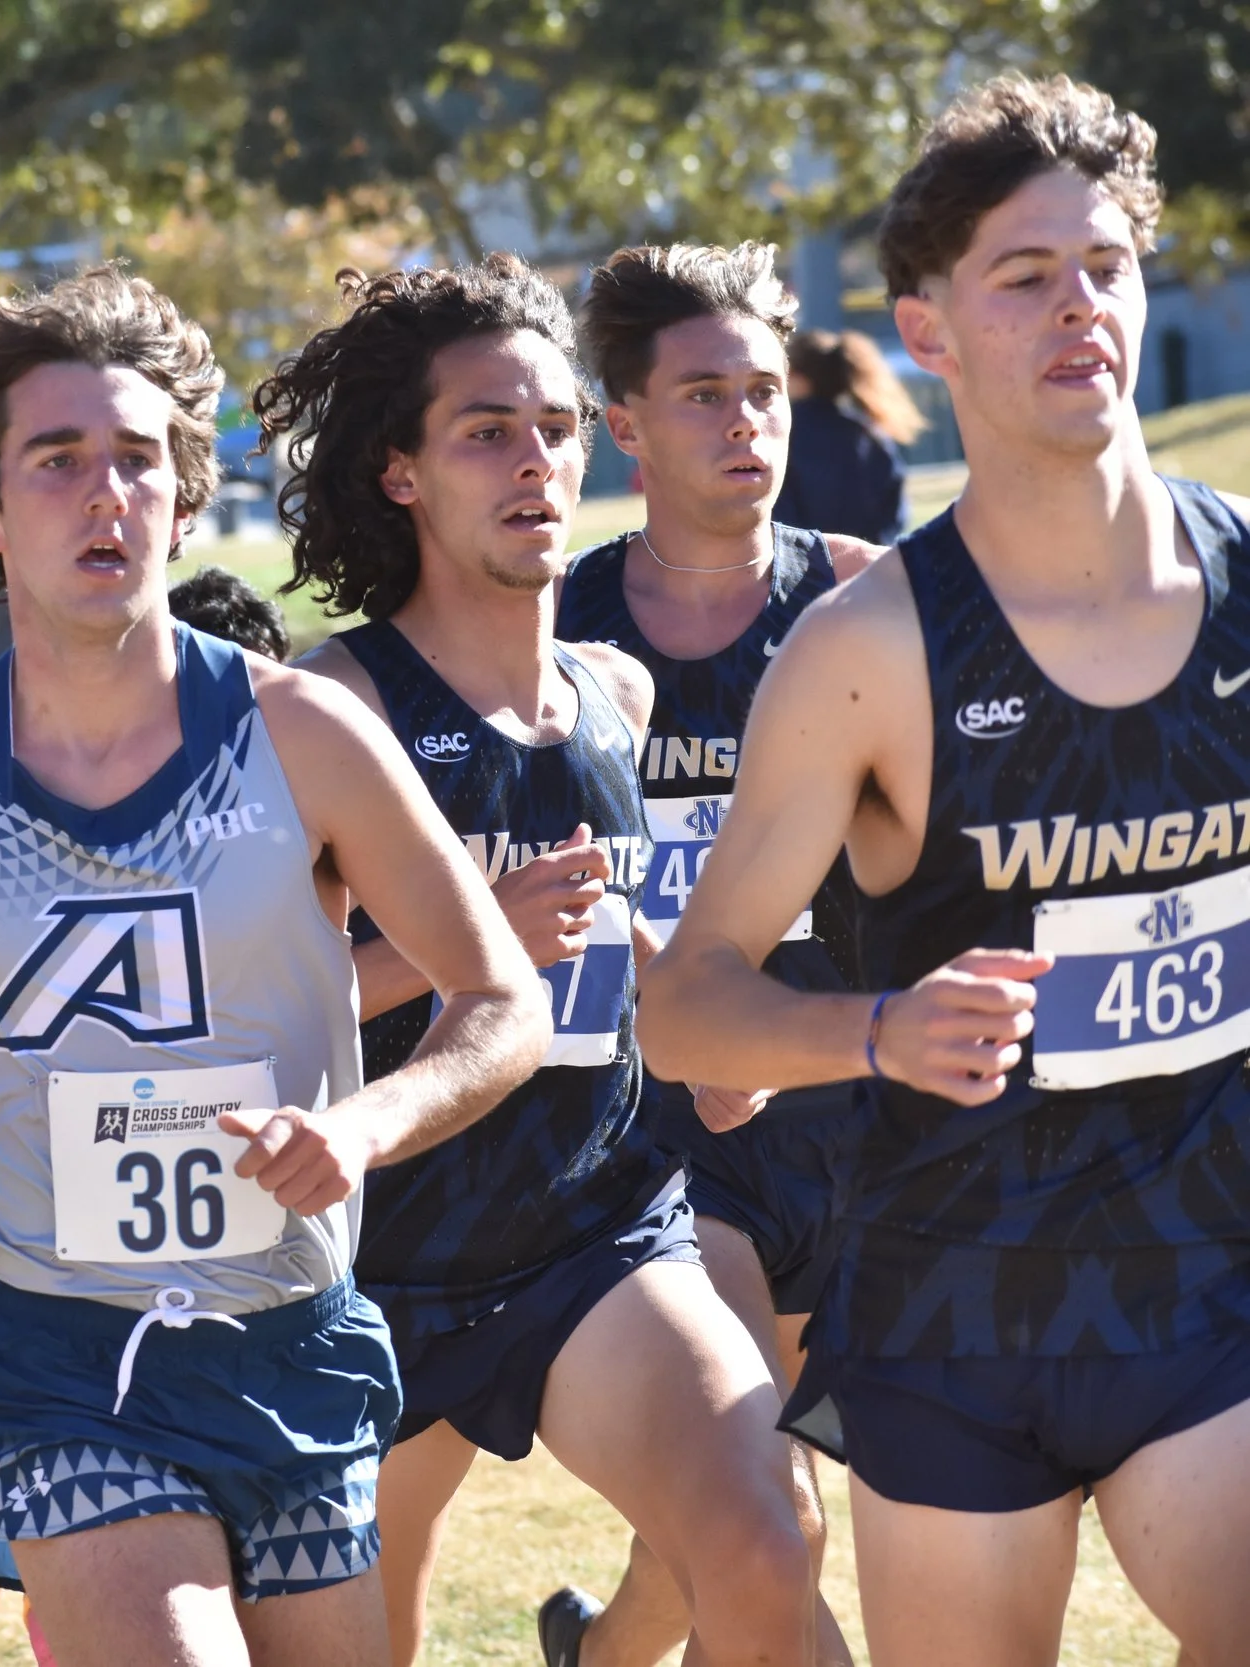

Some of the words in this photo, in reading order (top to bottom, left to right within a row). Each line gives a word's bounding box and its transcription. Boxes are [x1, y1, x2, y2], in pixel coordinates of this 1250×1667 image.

[964, 696, 1026, 731] SAC
[422, 732, 470, 755] SAC
[185, 802, 269, 848] PBC
[1095, 940, 1224, 1041] 463
[131, 1119, 206, 1133] CHAMPIONSHIPS
[133, 1107, 178, 1122] CROSS
[181, 1100, 242, 1119] COUNTRY
[116, 1147, 225, 1253] 36
